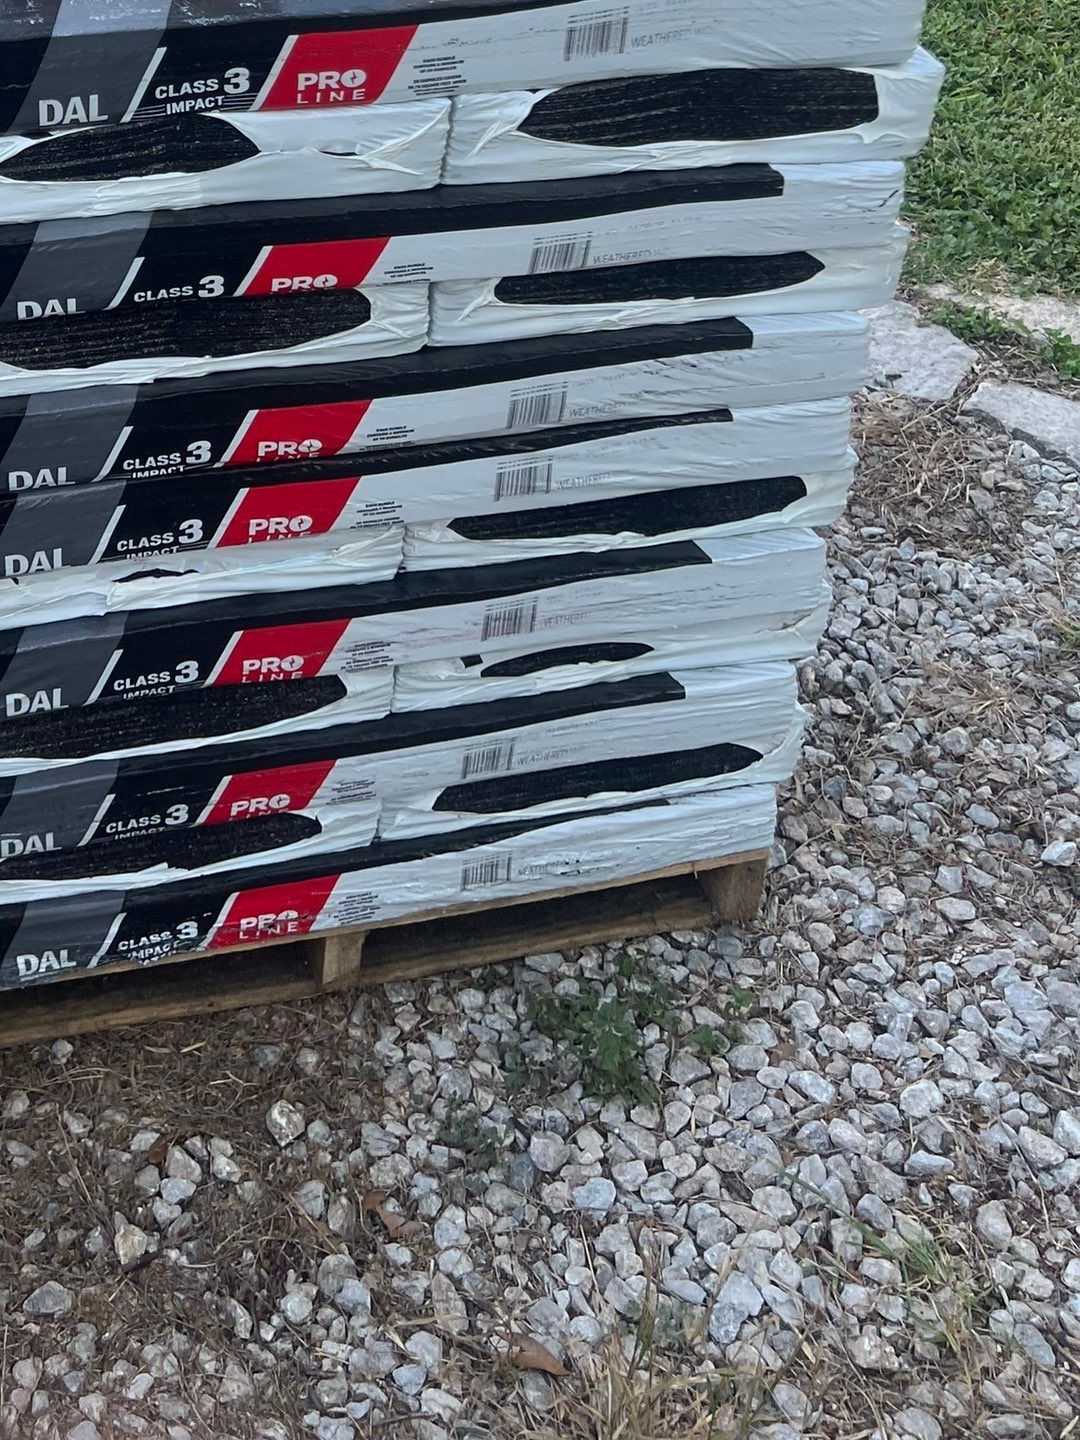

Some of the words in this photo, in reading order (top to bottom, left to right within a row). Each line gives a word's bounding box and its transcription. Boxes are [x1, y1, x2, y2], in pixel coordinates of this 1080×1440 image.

[155, 78, 220, 100] CLASS
[224, 67, 251, 95] 3
[297, 69, 367, 91] PRO
[166, 95, 226, 116] IMPACT
[296, 89, 367, 105] LINE
[38, 94, 109, 127] DAL
[134, 286, 195, 303] CLASS
[198, 275, 225, 299] 3
[271, 274, 338, 292] PRO
[17, 298, 87, 321] DAL
[123, 452, 182, 471] CLASS
[185, 441, 212, 464] 3
[258, 439, 323, 457] PRO
[8, 466, 76, 492] DAL
[117, 531, 175, 552] CLASS
[179, 519, 205, 544] 3
[248, 515, 314, 536] PRO
[113, 671, 171, 692] CLASS
[175, 660, 200, 684] 3
[242, 655, 305, 676] PRO
[242, 672, 304, 684] LINE
[5, 687, 70, 717] DAL
[123, 685, 176, 700] IMPACT
[230, 794, 291, 816] PRO
[105, 815, 162, 835] CLASS
[165, 804, 189, 826] 3
[0, 832, 63, 859] DAL
[117, 930, 172, 952] CLASS
[176, 921, 199, 940] 3
[16, 949, 77, 977] DAL
